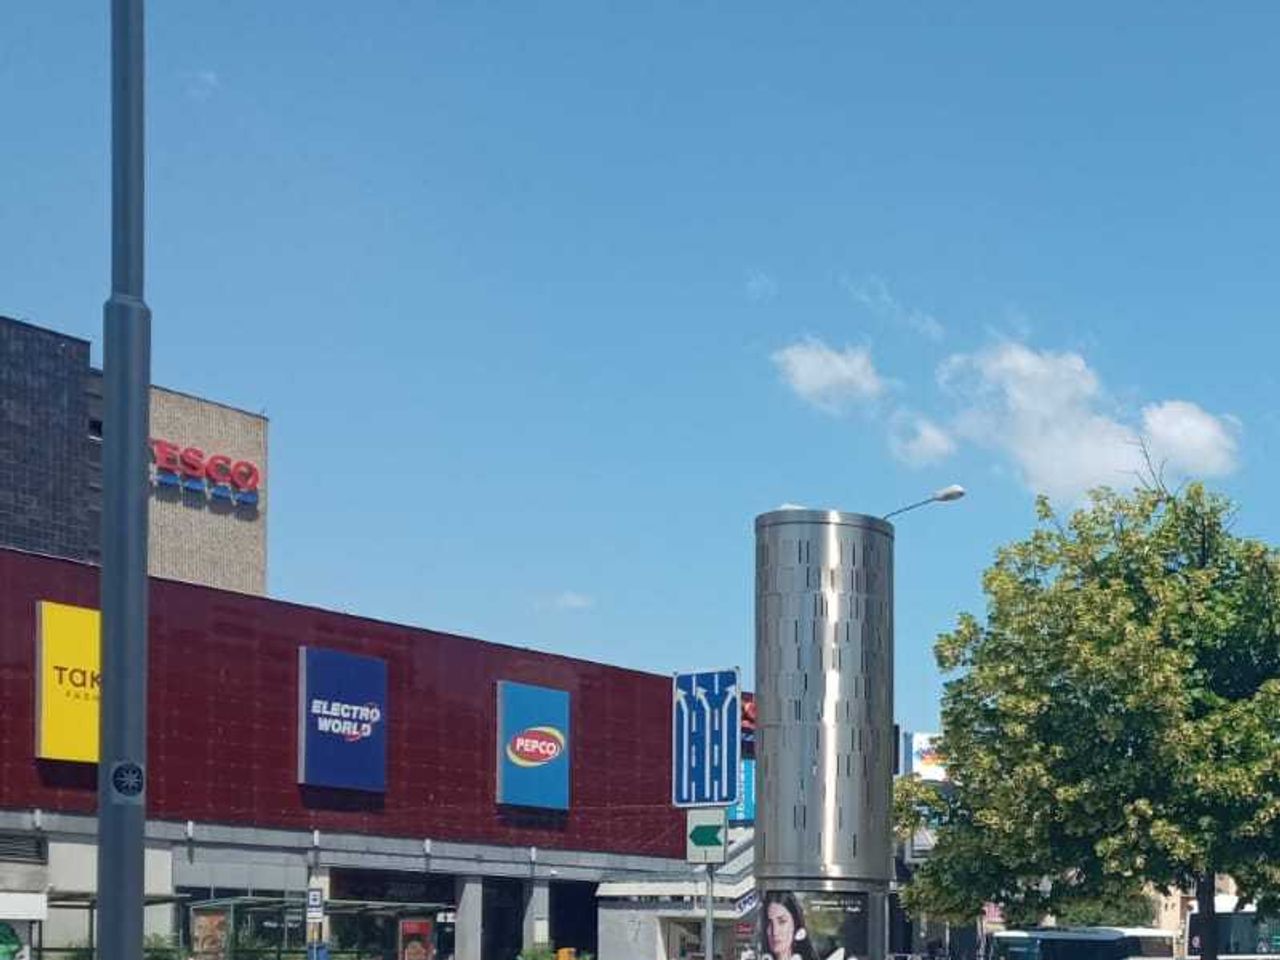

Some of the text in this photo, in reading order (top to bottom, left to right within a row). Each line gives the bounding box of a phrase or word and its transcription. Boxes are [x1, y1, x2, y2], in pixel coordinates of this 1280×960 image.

[149, 438, 260, 490] ESCO
[311, 699, 381, 722] ELECTRO
[318, 717, 372, 738] WORLD
[516, 737, 557, 756] PEPCO
